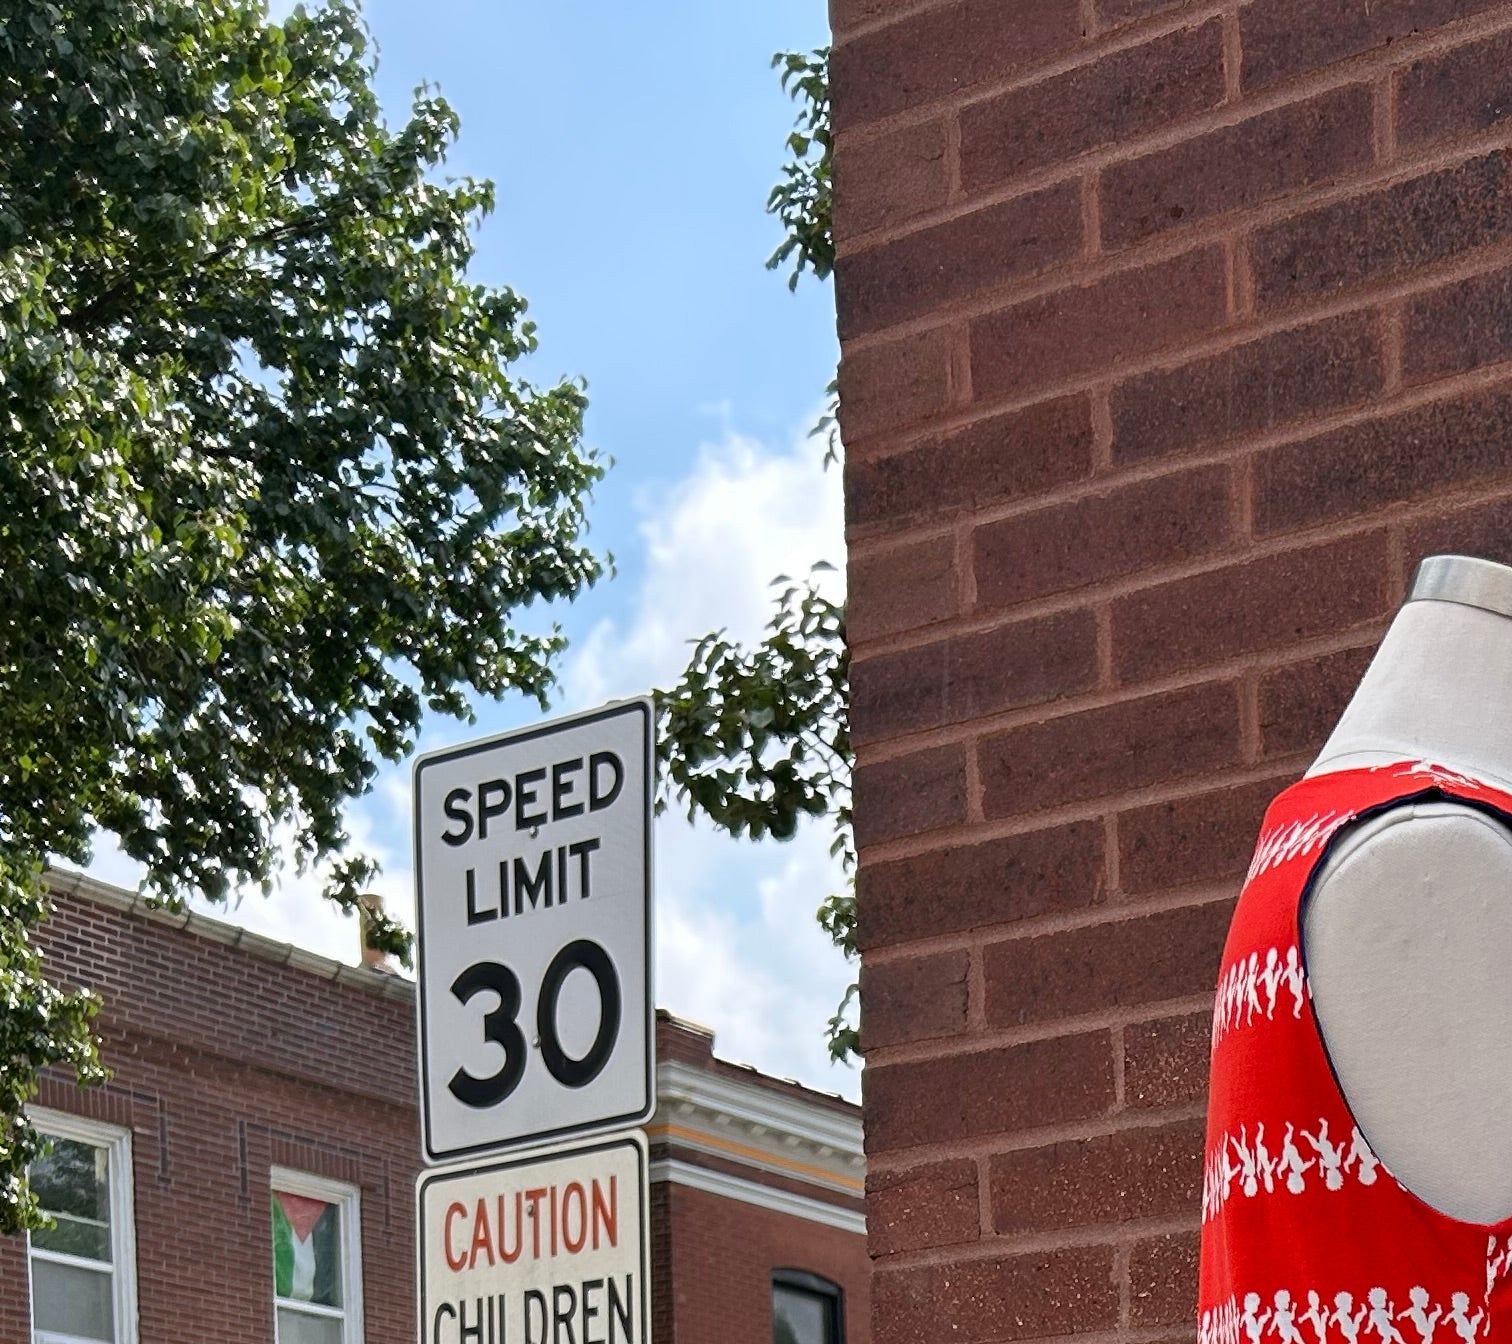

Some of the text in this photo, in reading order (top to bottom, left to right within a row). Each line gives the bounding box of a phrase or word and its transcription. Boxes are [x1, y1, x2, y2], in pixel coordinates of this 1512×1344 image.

[441, 751, 624, 846] SPEED
[466, 838, 600, 926] LIMIT
[448, 939, 622, 1109] 30
[444, 1175, 617, 1272] CAUTION
